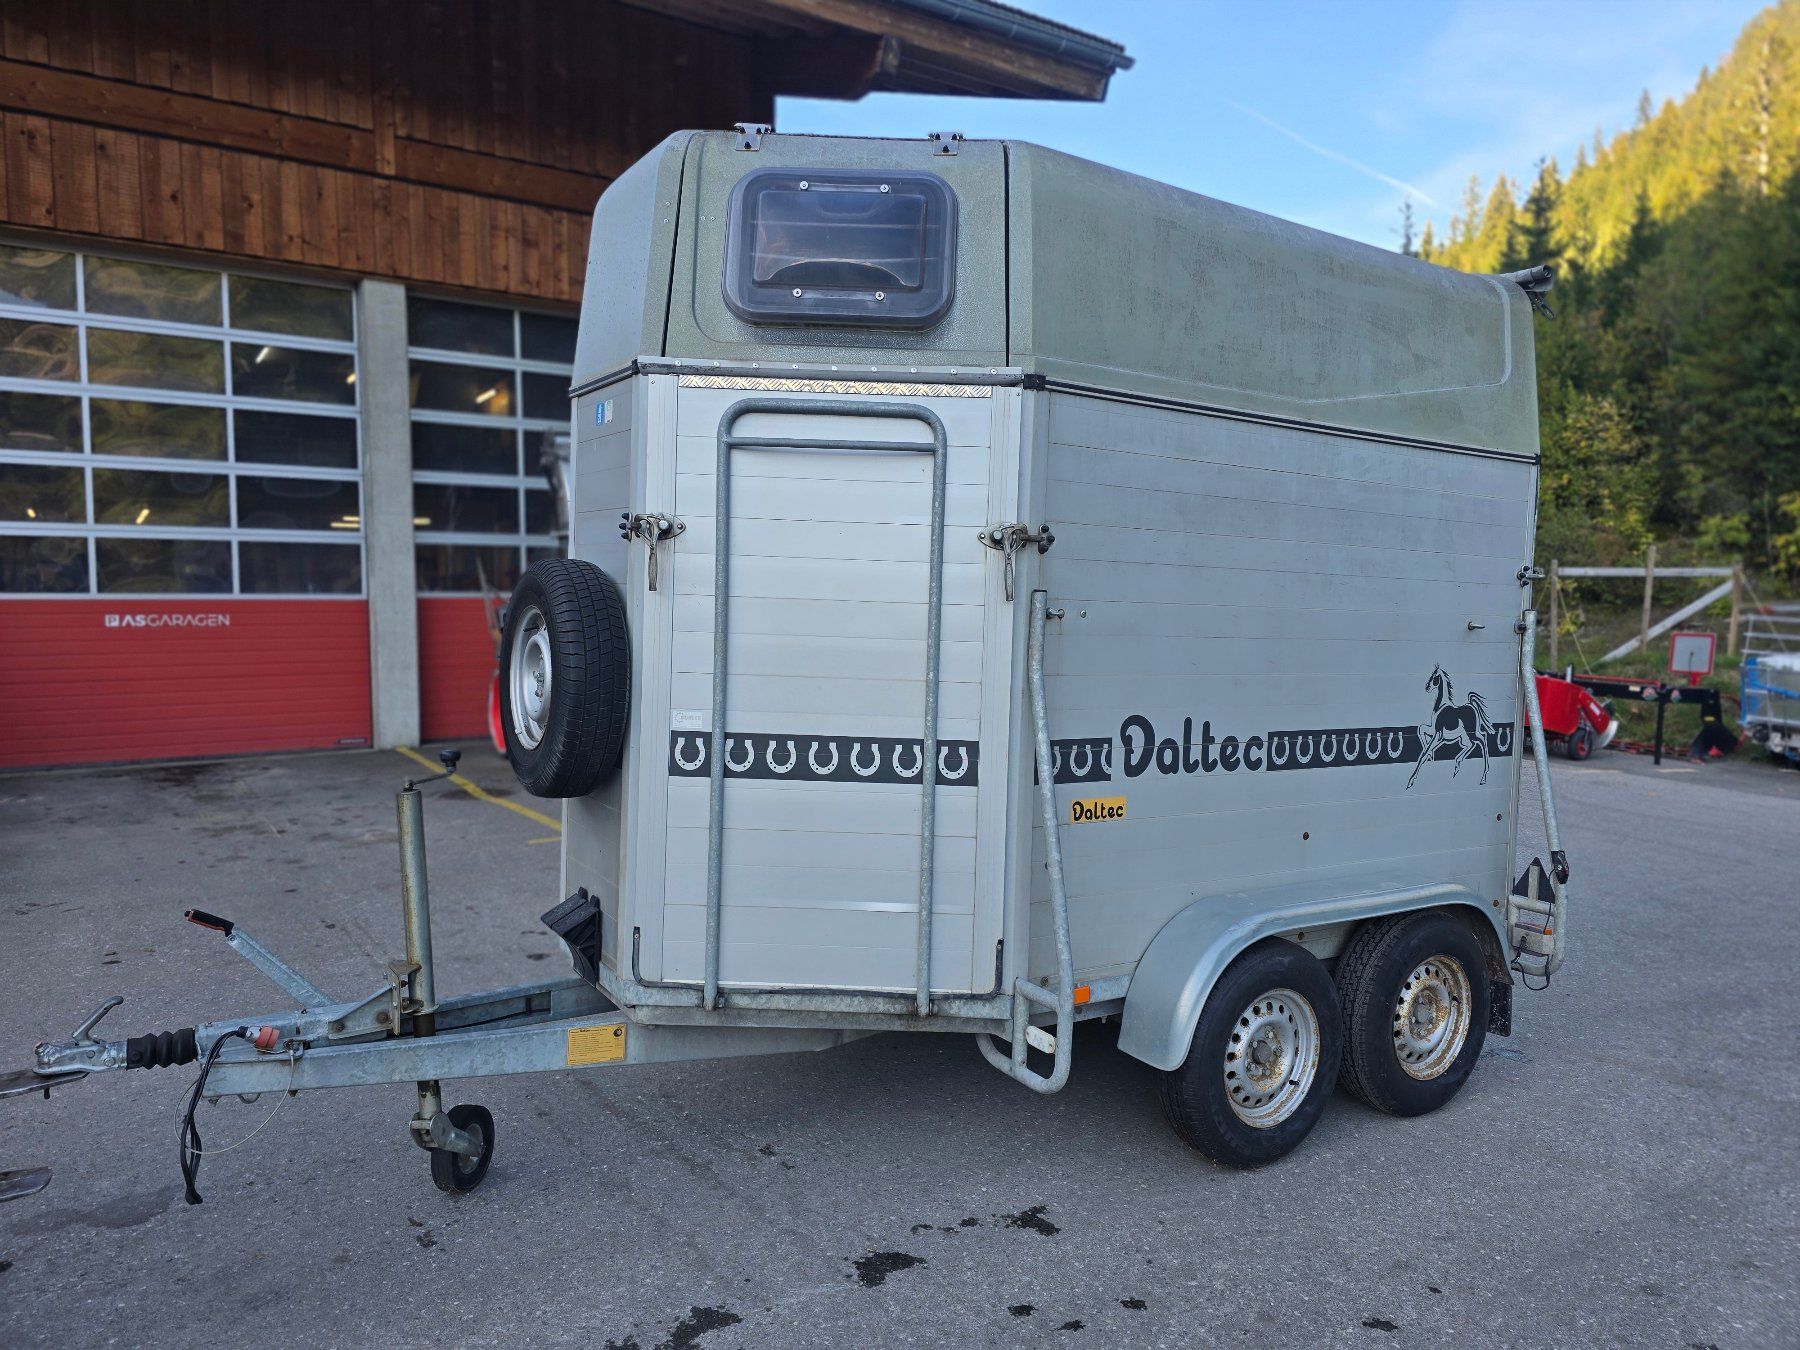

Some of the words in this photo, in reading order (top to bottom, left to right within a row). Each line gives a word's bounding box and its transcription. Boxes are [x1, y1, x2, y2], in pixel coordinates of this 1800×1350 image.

[121, 614, 231, 627] ASGARAGEN
[1120, 714, 1264, 778] Daltec
[1072, 800, 1124, 822] Daltec
